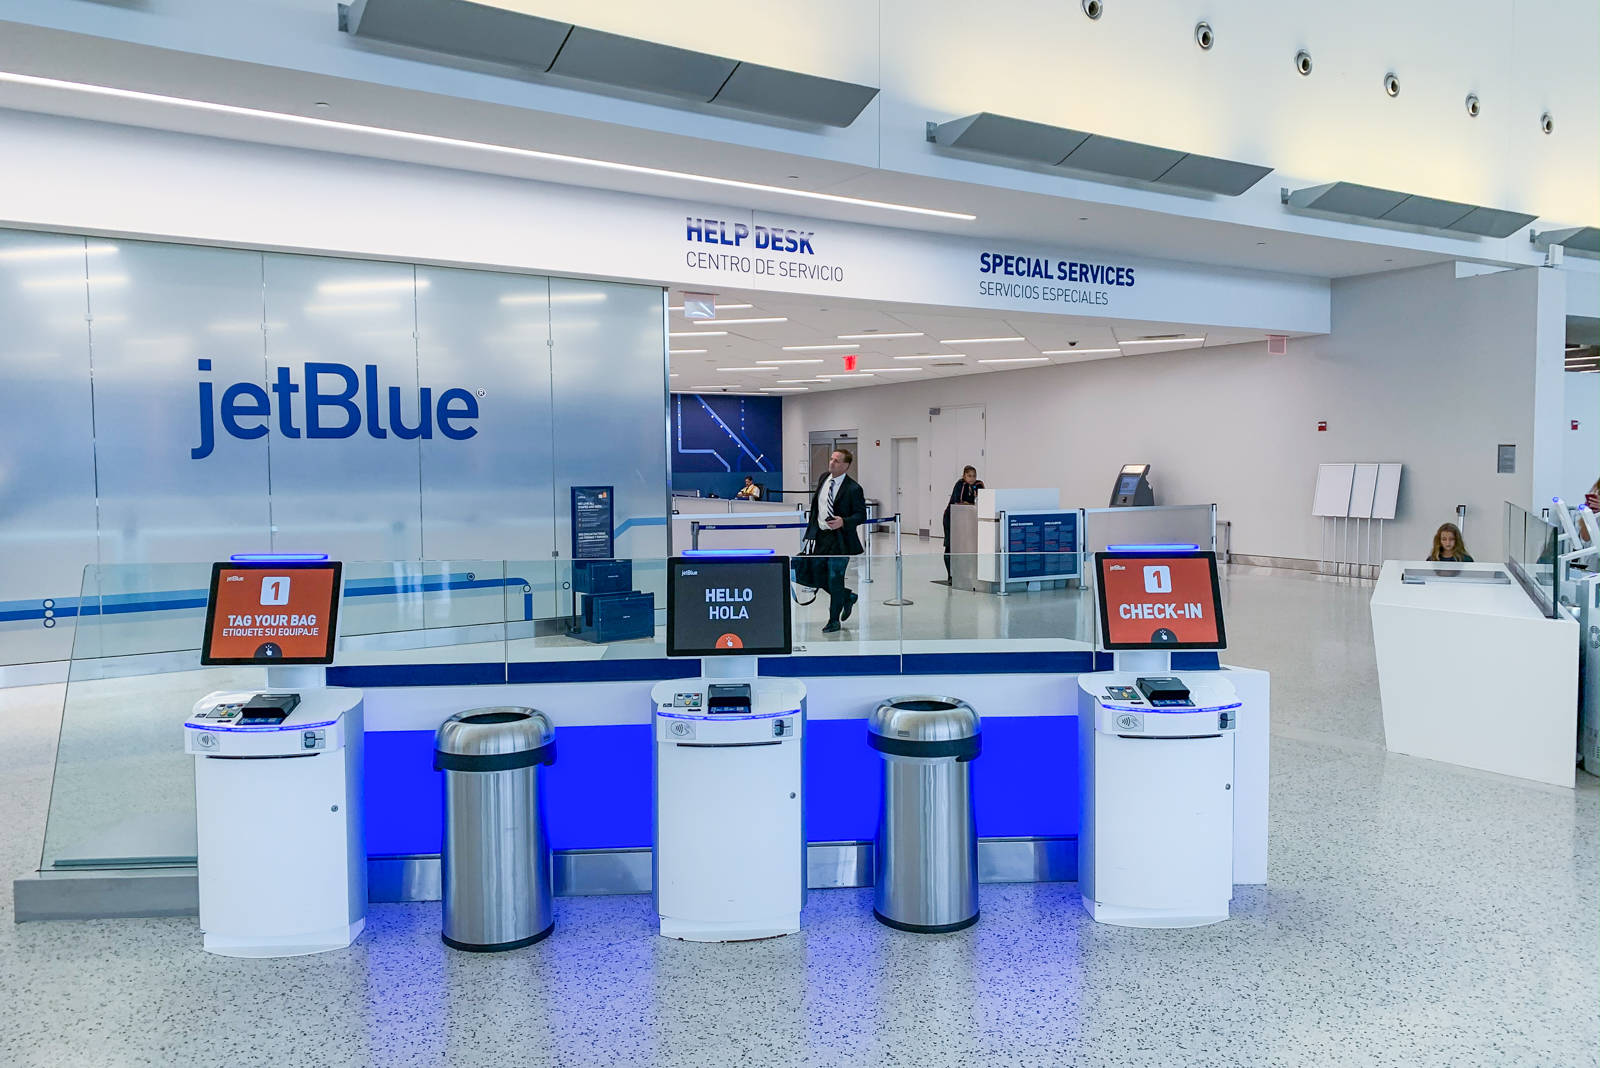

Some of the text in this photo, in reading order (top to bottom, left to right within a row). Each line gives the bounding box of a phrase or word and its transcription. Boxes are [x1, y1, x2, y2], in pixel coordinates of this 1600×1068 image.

[686, 217, 815, 255] HELP DESK
[686, 251, 844, 282] CENTRO DE SERVICIO
[979, 252, 1135, 287] SPECIAL SERVICES
[979, 280, 1109, 305] SERVICIOS ESPECIALES
[1152, 570, 1162, 589] 1
[270, 581, 281, 601] 1
[705, 588, 753, 603] HELLO
[228, 614, 317, 627] TAG YOUR BAG
[709, 605, 749, 620] HOLA
[1119, 603, 1203, 620] CHECK-IN
[222, 627, 319, 637] ETIQUETE SU EQUIPAJE
